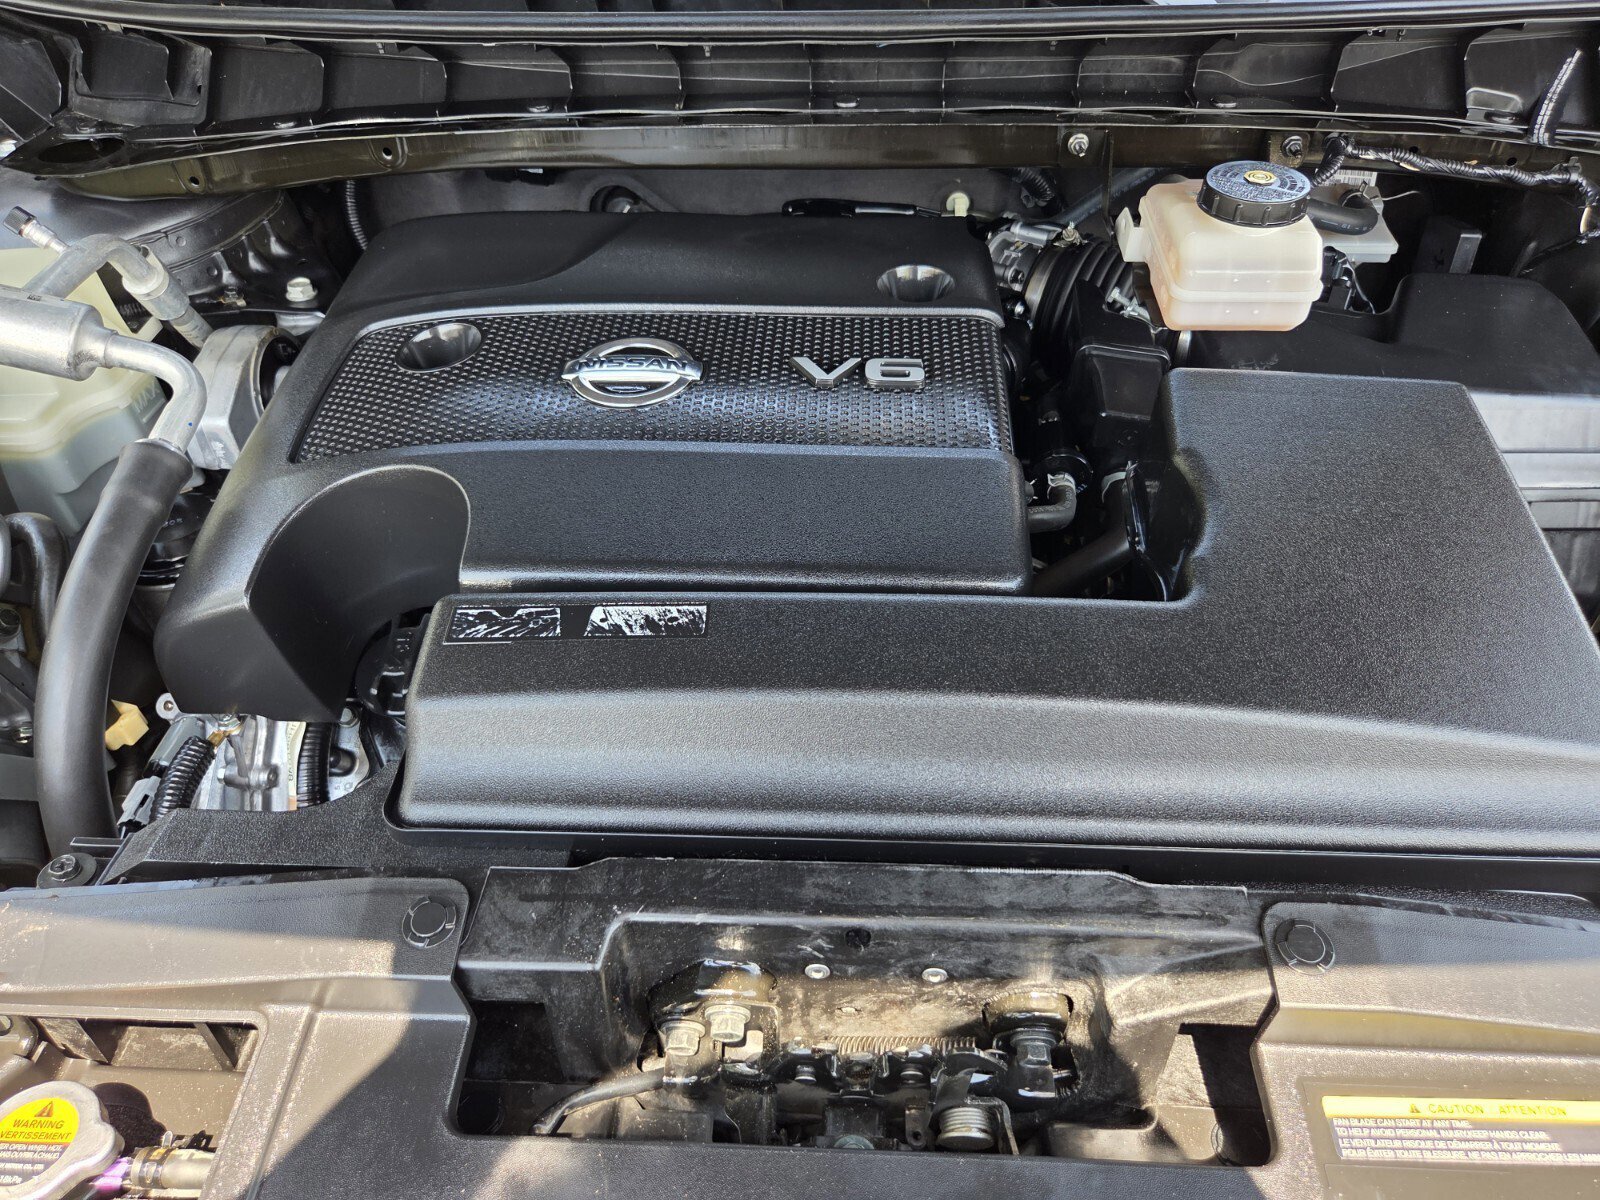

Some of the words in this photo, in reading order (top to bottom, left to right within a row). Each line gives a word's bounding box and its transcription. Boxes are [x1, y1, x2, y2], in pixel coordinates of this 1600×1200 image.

[577, 356, 689, 371] NISSAN
[789, 357, 925, 388] V6
[1428, 1103, 1484, 1114] CAUTION
[1498, 1104, 1567, 1115] ATTENTION
[13, 1118, 65, 1129] WARNING
[1333, 1117, 1349, 1127] FAN
[1350, 1118, 1377, 1127] BLADE
[1377, 1118, 1395, 1127] CAN
[1396, 1118, 1421, 1128] START
[1422, 1119, 1432, 1128] AT
[1433, 1119, 1450, 1128] ANY
[0, 1130, 72, 1140] VERTISSEMENT
[1335, 1127, 1348, 1136] TO
[1348, 1127, 1370, 1137] HELP
[1371, 1128, 1395, 1137] AVOID
[1396, 1128, 1440, 1138] PERSONAL
[1489, 1130, 1519, 1140] HANDS
[1402, 1139, 1434, 1149] RISQUE
[1435, 1140, 1447, 1149] DE
[1500, 1141, 1523, 1151] TOUT
[1342, 1148, 1366, 1158] POUR
[1395, 1149, 1422, 1158] TOUTE
[1468, 1151, 1481, 1160] NE
[1481, 1151, 1498, 1160] PAS
[1498, 1151, 1511, 1161] EN
